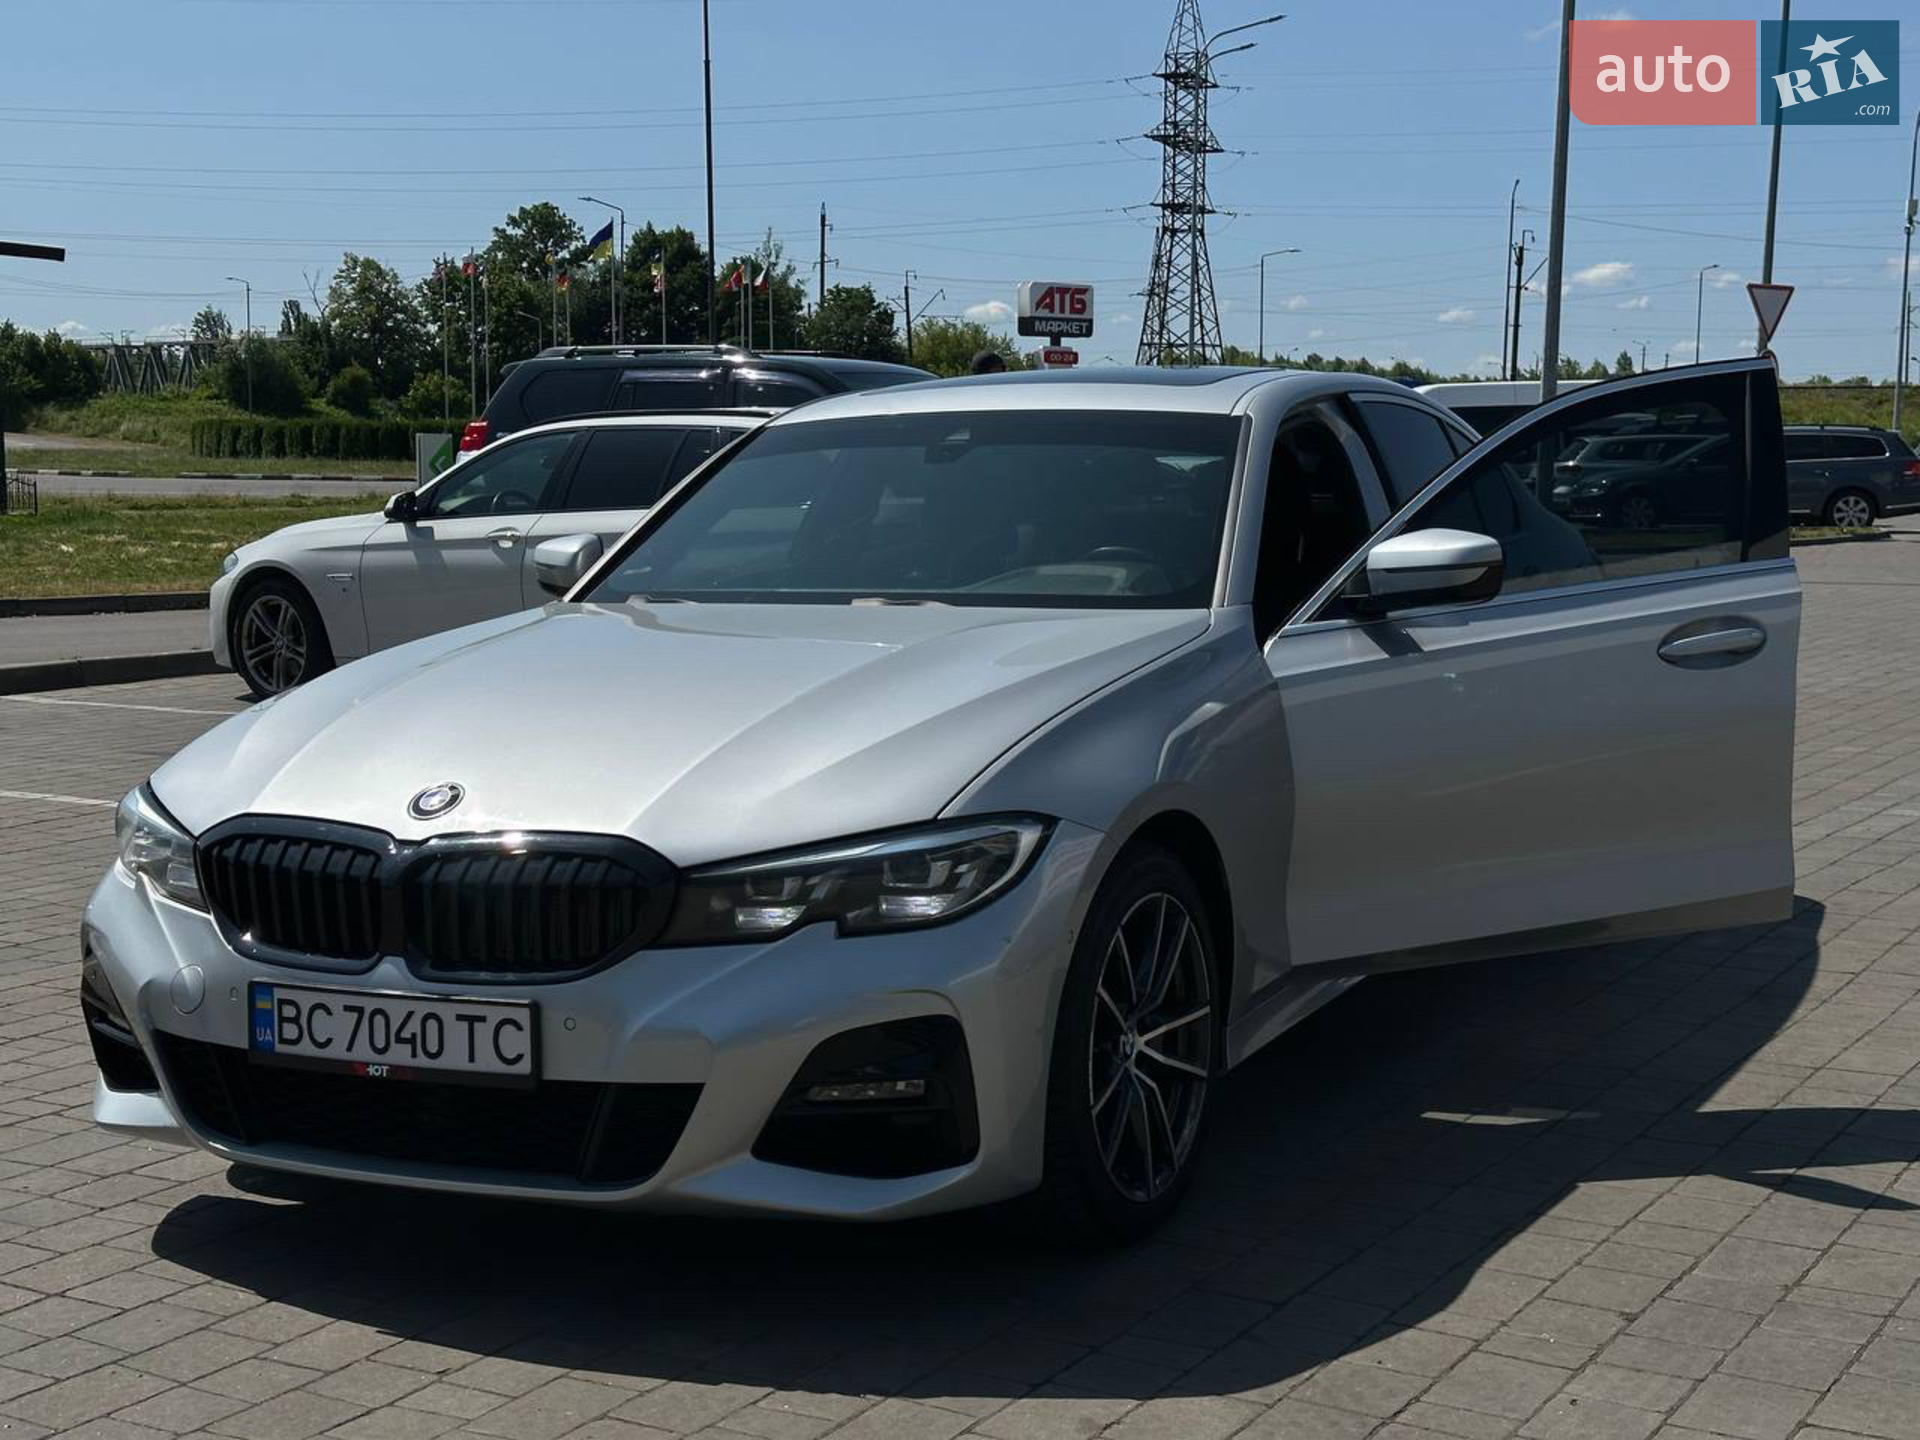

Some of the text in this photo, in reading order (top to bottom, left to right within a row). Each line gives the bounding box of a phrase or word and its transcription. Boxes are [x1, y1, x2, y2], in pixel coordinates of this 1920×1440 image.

[1035, 286, 1089, 315] АТБ
[1034, 321, 1090, 334] МАРКЕТ
[256, 1026, 273, 1042] UA
[343, 1004, 445, 1060] 7040
